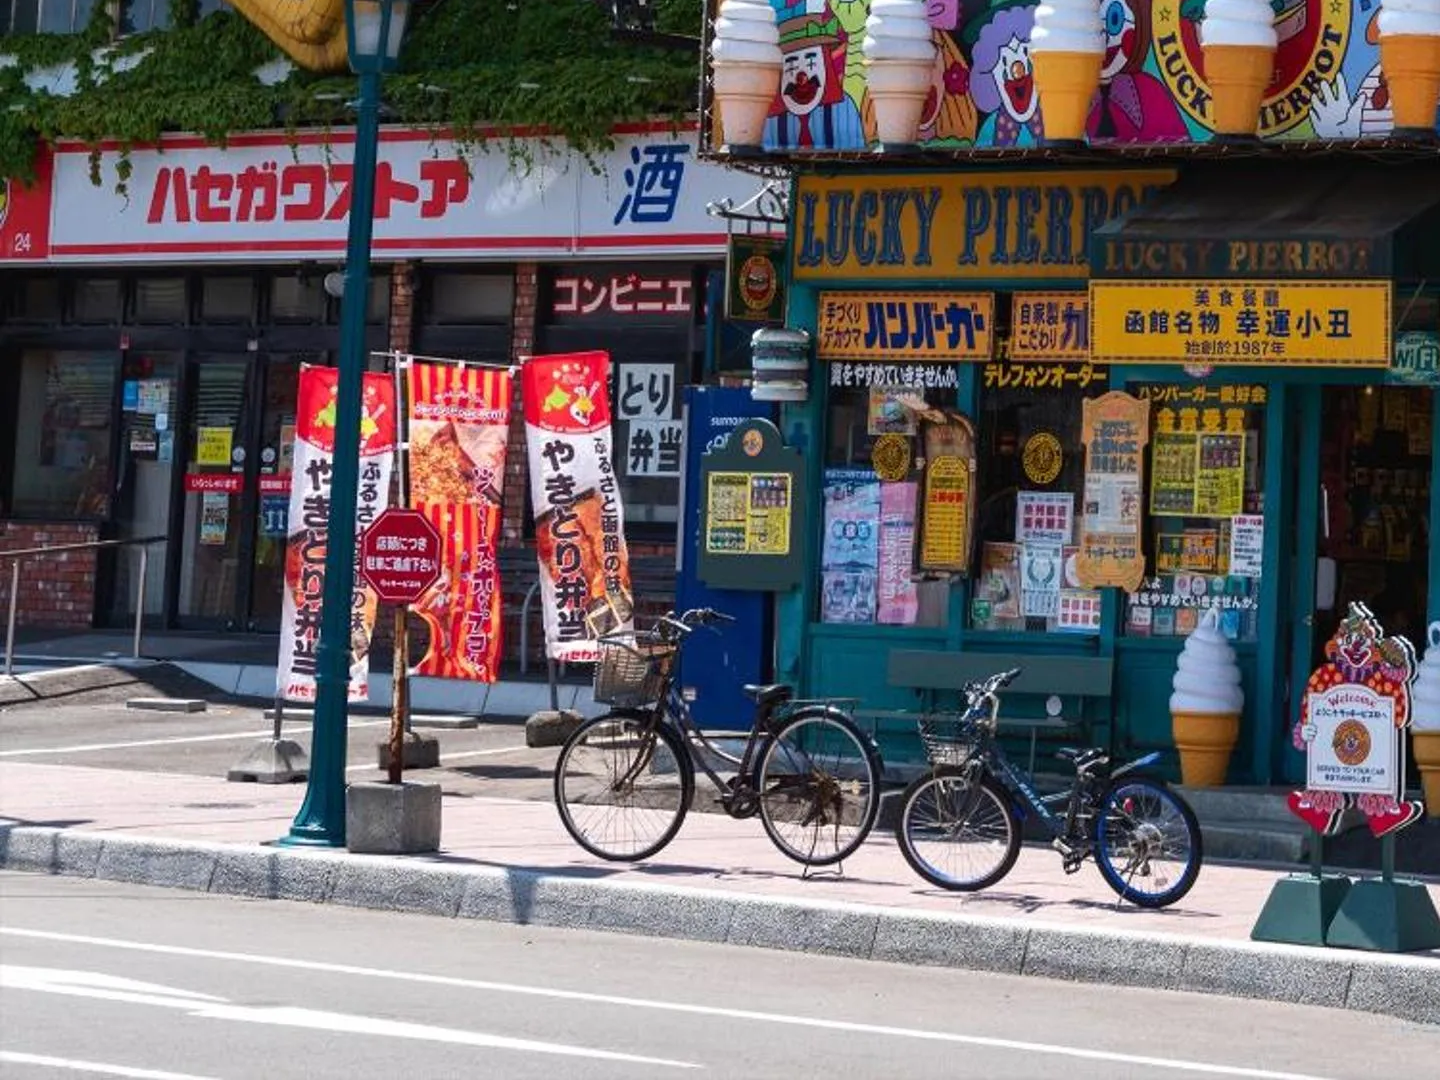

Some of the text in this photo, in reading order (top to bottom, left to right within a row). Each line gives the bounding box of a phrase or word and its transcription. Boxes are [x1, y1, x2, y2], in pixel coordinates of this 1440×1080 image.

[1158, 23, 1343, 129] LUCK IERROT
[614, 143, 690, 226] 酒
[14, 232, 31, 252] 24
[798, 184, 1143, 267] LUCKY PIERR
[1104, 240, 1373, 271] LUCKY PIERROT
[864, 301, 985, 350] ハンバーガー
[1124, 308, 1353, 339] 函館名物 幸運小丑
[983, 364, 1108, 389] テレフォンオーダー
[543, 439, 590, 642] やきとり弁当
